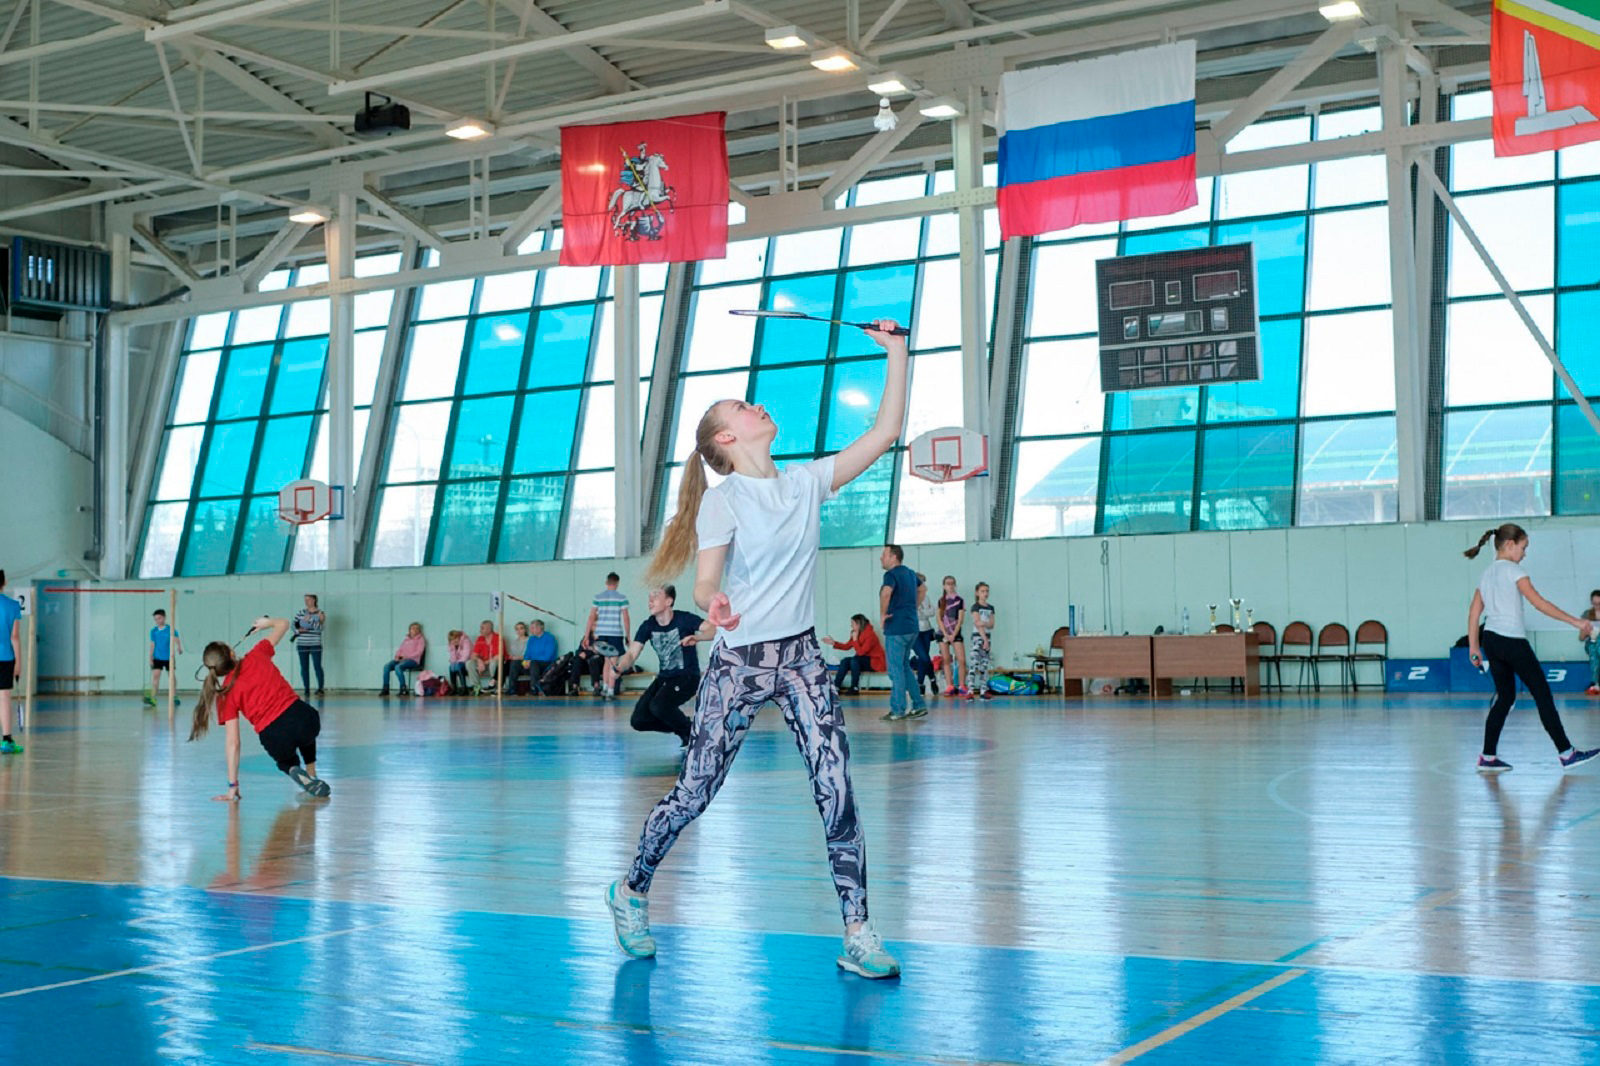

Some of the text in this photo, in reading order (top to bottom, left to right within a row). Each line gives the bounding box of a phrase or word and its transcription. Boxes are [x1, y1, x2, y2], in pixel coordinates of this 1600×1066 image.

[18, 595, 25, 610] 2
[1408, 666, 1429, 680] 2
[1546, 669, 1567, 682] 3
